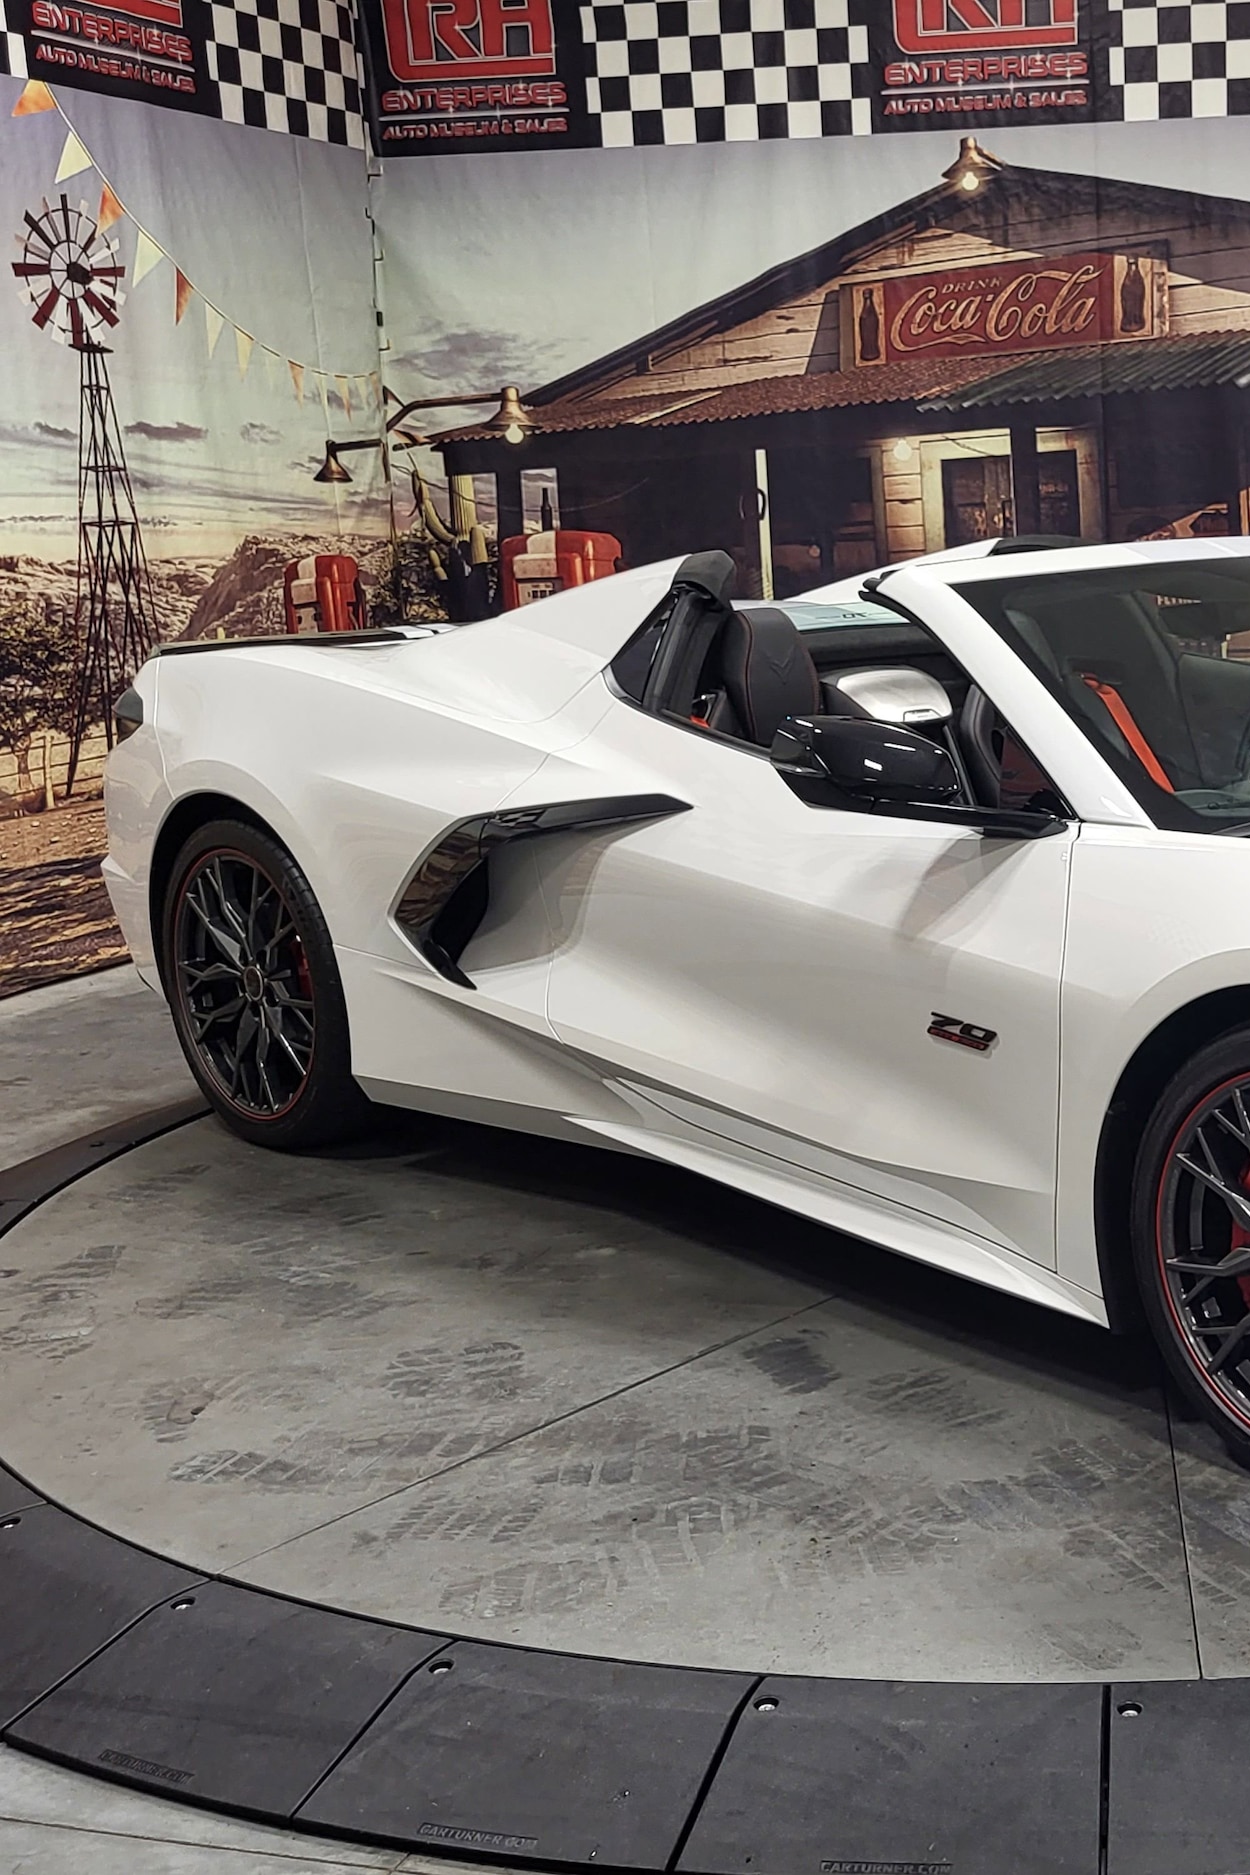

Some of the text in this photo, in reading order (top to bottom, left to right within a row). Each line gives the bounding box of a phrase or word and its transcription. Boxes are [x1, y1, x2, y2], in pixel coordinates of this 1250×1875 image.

[32, 1, 193, 62] ENTERPRISES
[35, 44, 77, 67] AUTO
[78, 52, 141, 80] MUSEUM
[151, 70, 197, 94] SALES
[884, 52, 1089, 86] ENTERPRISES
[381, 81, 568, 112] ENTERPRISES
[883, 98, 933, 116] AUTO
[935, 94, 1013, 112] MUSEUM
[1028, 90, 1088, 107] SALES
[382, 123, 428, 140] AUTO
[430, 121, 500, 138] MUSEUM
[514, 117, 568, 135] SALES
[941, 277, 1002, 295] DRINK
[890, 264, 1104, 352] Coca-Cola
